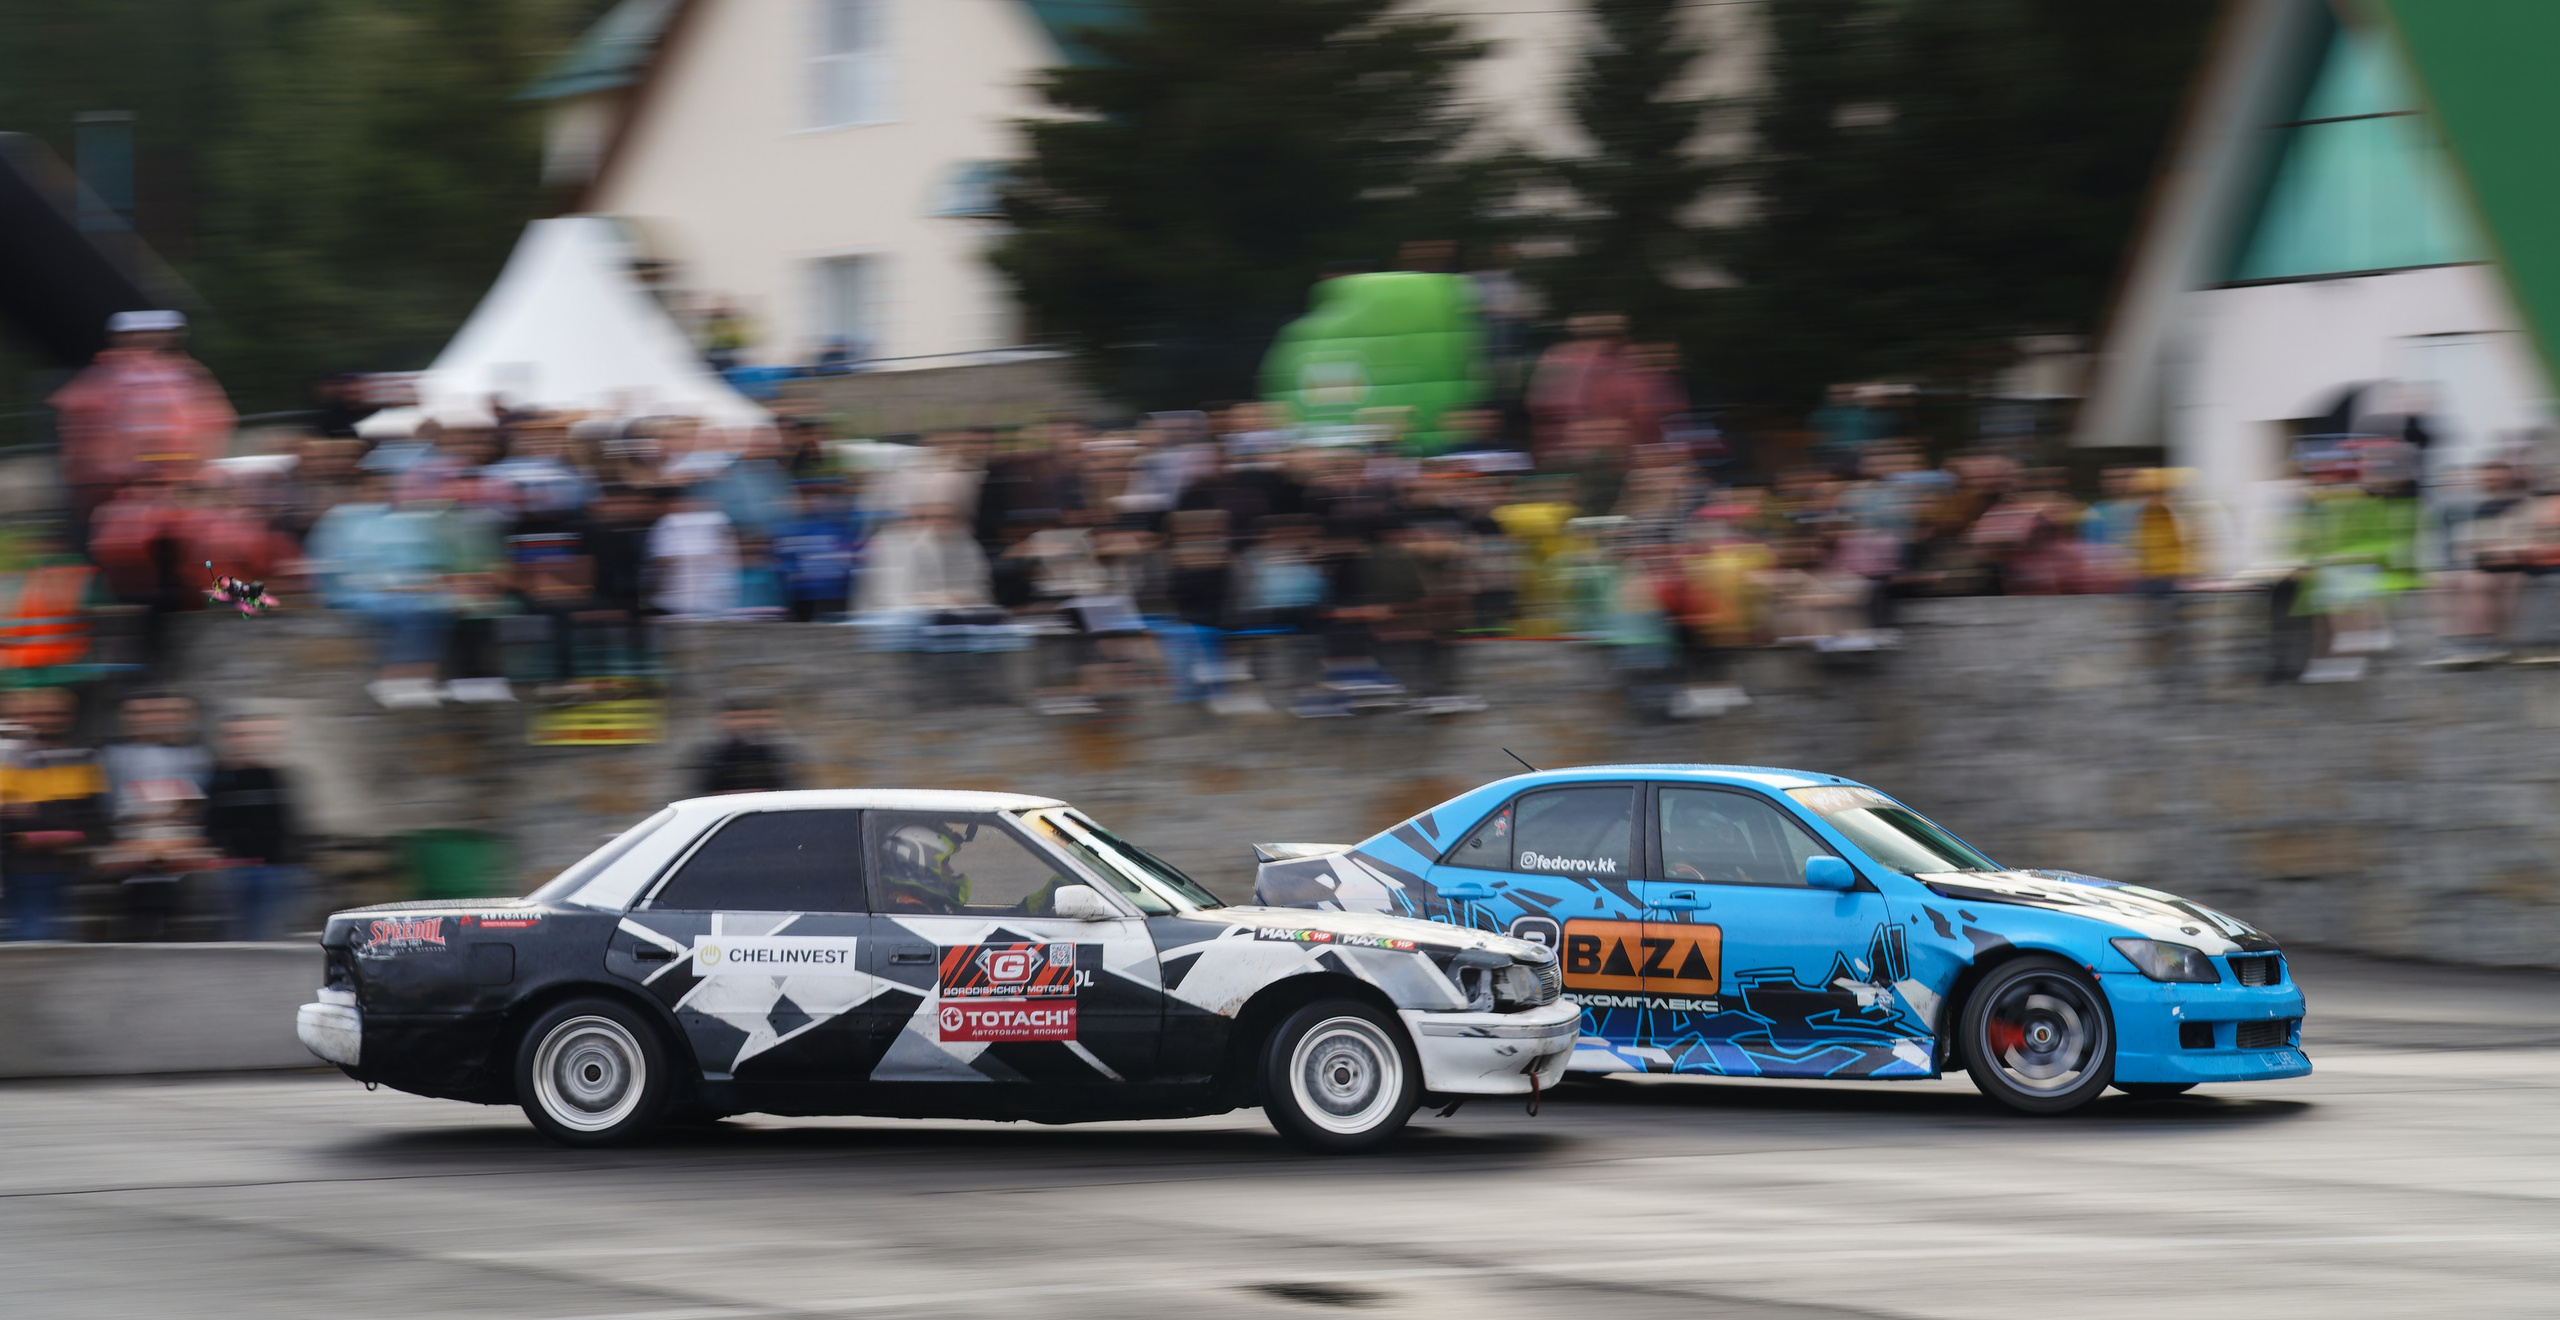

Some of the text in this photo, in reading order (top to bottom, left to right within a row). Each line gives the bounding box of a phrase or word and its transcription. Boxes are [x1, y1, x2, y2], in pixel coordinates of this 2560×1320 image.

[367, 916, 446, 948] SPEEDOL
[1259, 927, 1331, 941] MAX HP
[1342, 934, 1414, 949] MAX HP
[729, 948, 849, 964] CHELINVEST
[1567, 933, 1714, 981] BAZA
[943, 984, 1070, 996] GORODISHCHEV MOTORS
[966, 1010, 1069, 1027] TOTACHI
[971, 1028, 1069, 1037] АВТОТОВАРЫ ЯПОНИЯ
